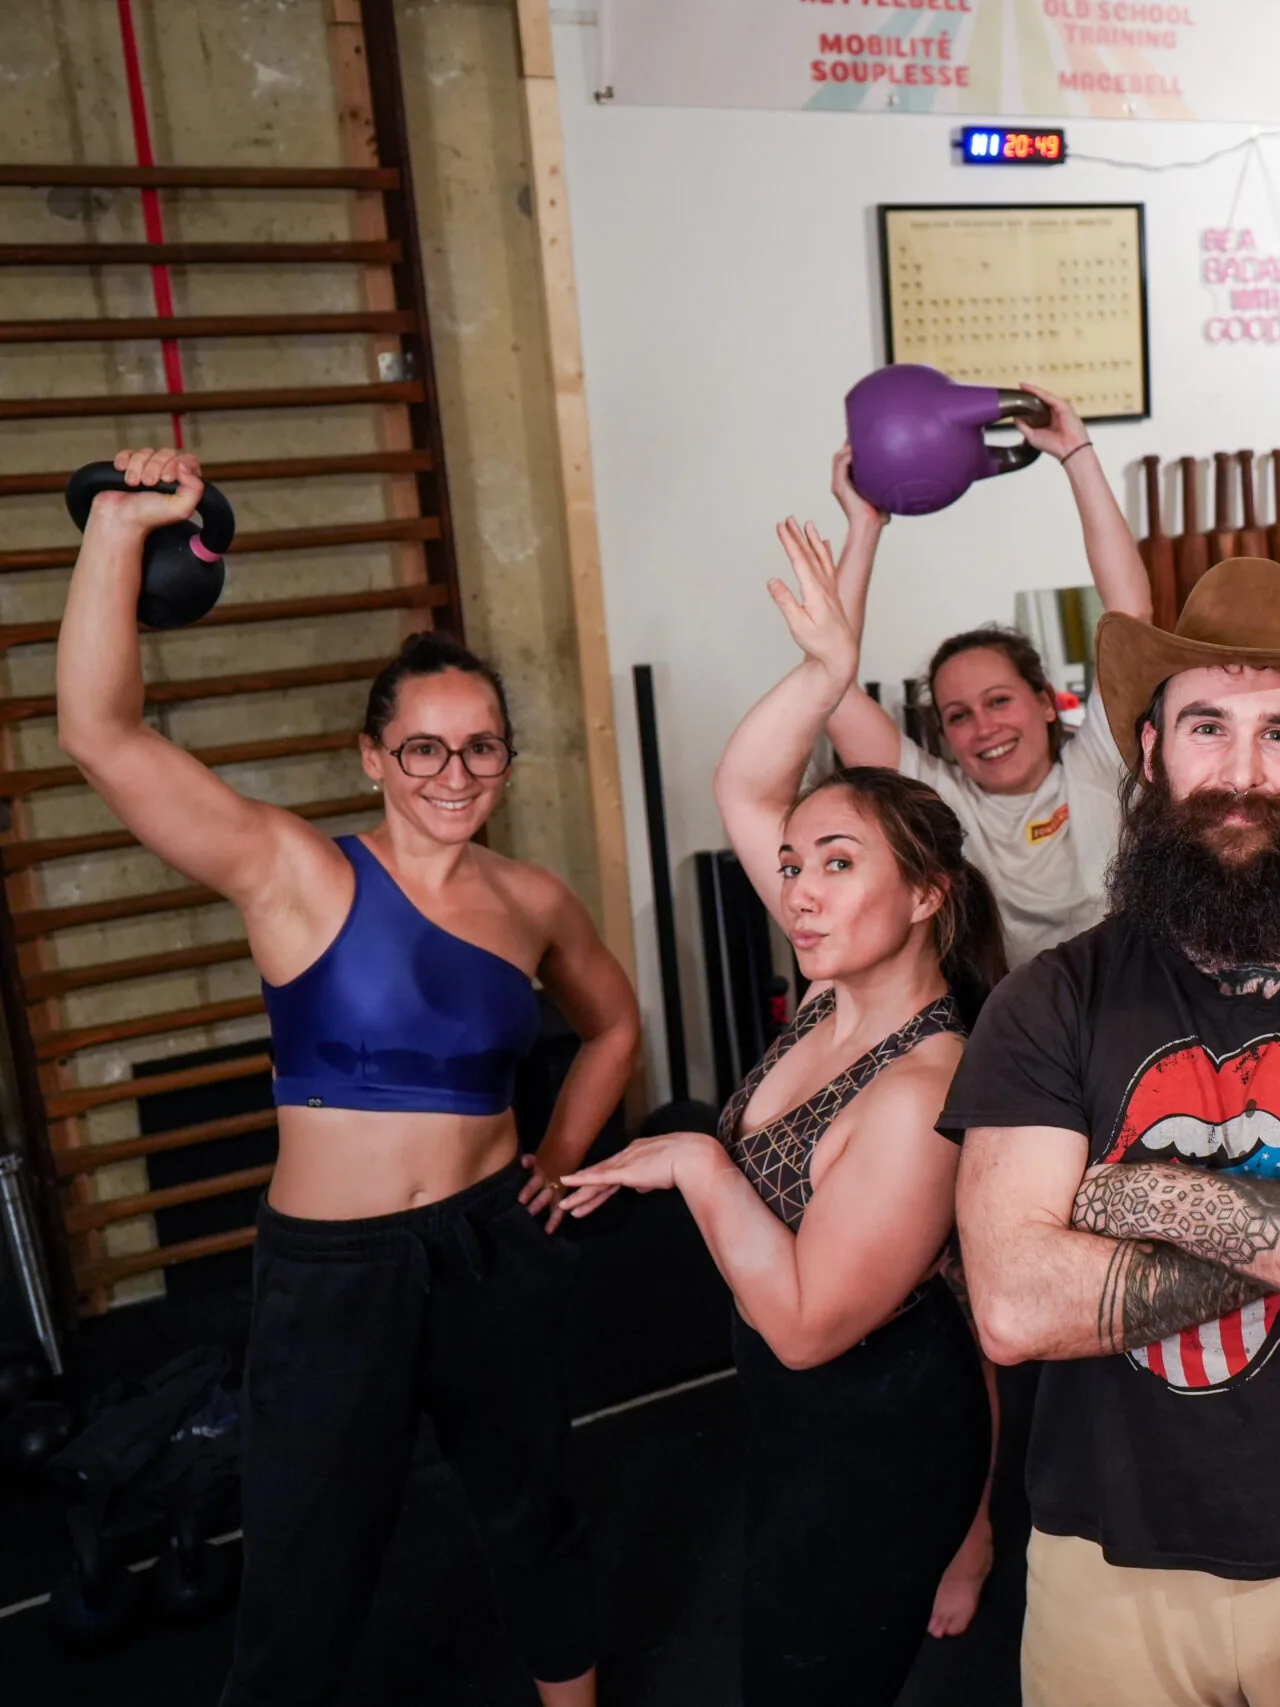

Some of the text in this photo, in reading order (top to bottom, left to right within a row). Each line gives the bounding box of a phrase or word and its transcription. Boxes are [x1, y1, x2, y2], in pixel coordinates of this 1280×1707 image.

[1043, 0, 1195, 26] OLD SCHOOL
[819, 30, 952, 60] MOBILITÉ
[1064, 23, 1177, 50] TRAINING
[810, 59, 970, 87] SOUPLESSE
[1058, 71, 1183, 96] MACEBELL
[1003, 133, 1060, 159] 20:49
[1238, 228, 1257, 251] A
